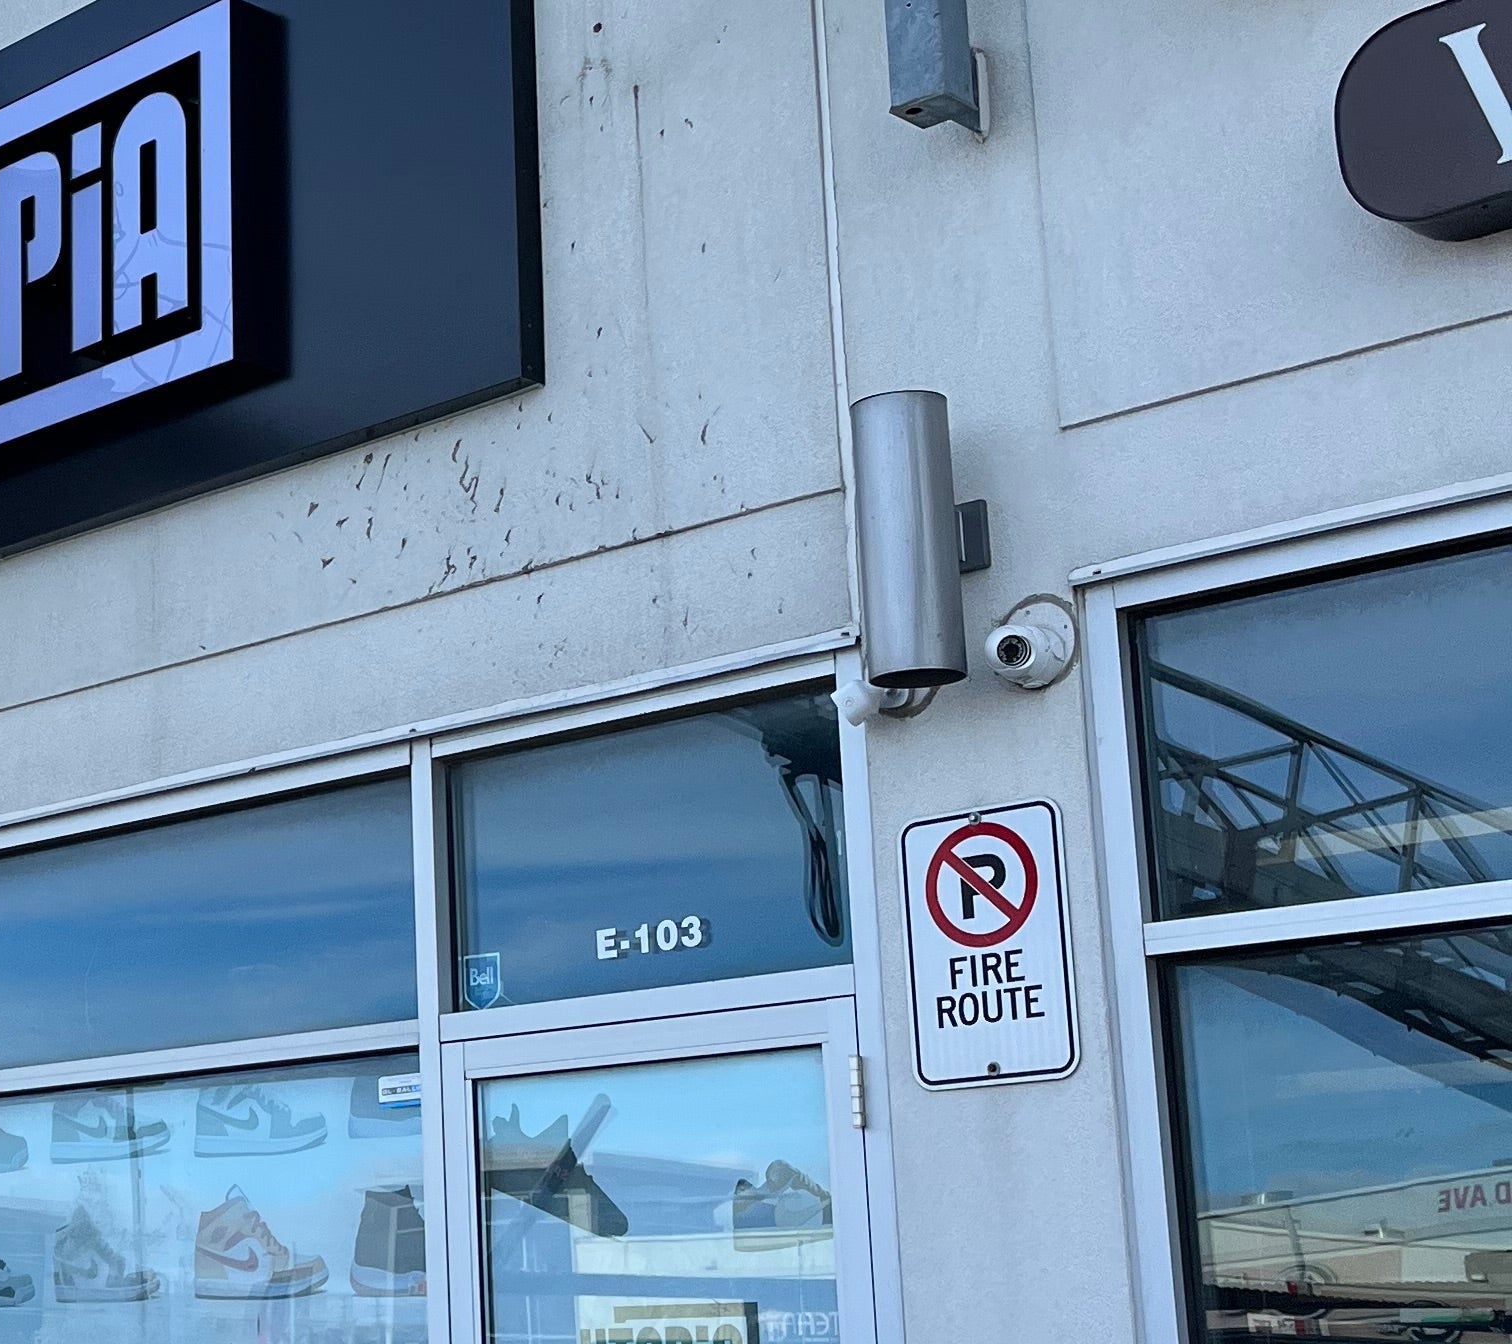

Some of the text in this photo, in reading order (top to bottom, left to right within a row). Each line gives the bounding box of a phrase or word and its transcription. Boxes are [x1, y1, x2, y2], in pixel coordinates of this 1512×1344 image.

[595, 915, 704, 960] E-103
[470, 966, 494, 986] Bell
[949, 948, 1025, 991] FIRE
[936, 984, 1046, 1029] ROUTE
